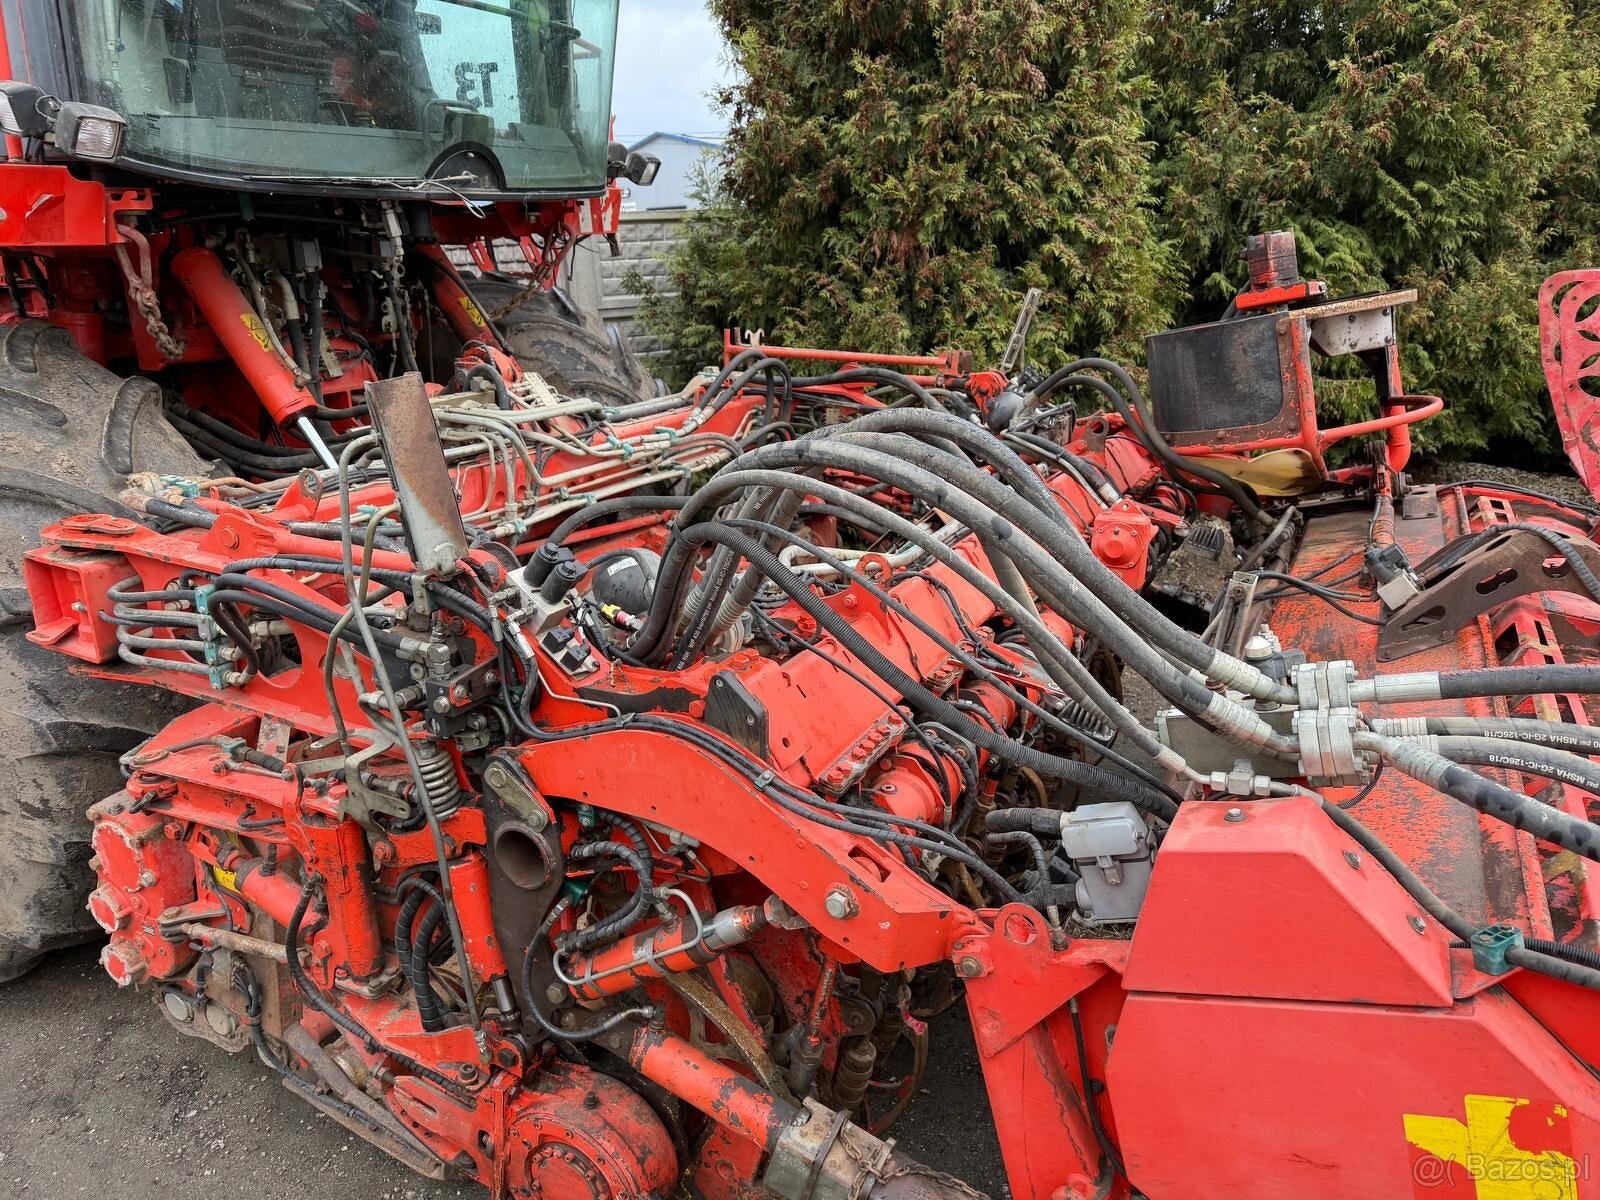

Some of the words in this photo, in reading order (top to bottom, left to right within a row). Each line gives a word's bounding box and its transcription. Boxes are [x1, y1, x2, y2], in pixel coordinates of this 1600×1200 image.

[1483, 729, 1548, 742] 2G-IC-126C/18
[1549, 734, 1578, 745] MSHA
[1489, 754, 1555, 774] 2G-IC-126C/18
[1557, 768, 1585, 784] MSHA
[1585, 780, 1600, 789] psi
